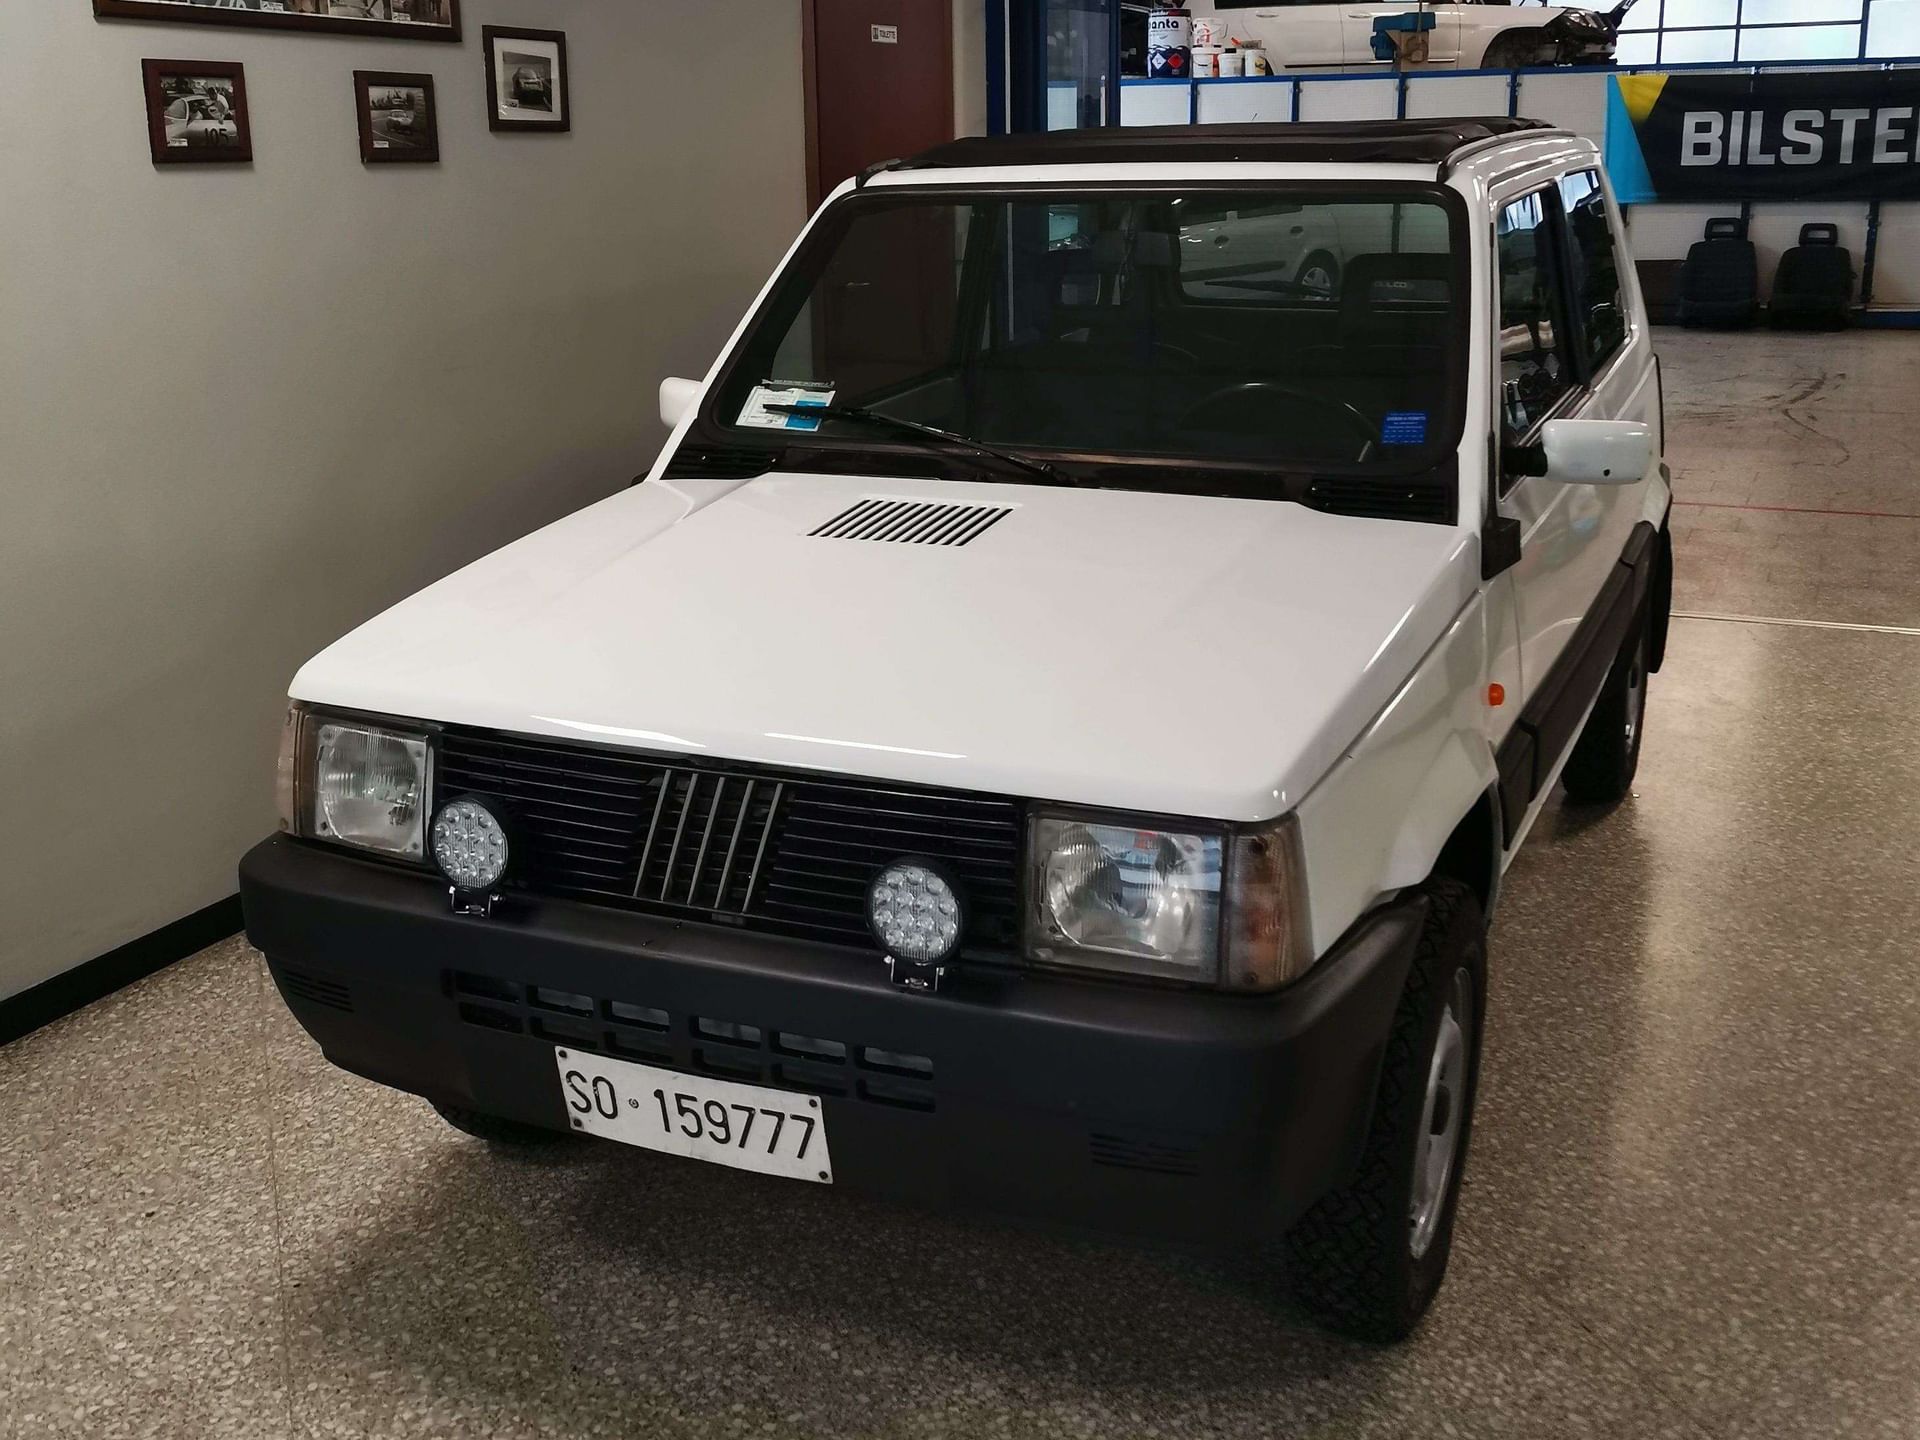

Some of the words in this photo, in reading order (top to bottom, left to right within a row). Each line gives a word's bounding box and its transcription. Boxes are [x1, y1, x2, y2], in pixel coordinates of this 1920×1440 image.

[204, 127, 228, 144] 105
[1680, 106, 1920, 166] BILSTE
[565, 1070, 619, 1120] SO
[653, 1088, 816, 1160] 159777
